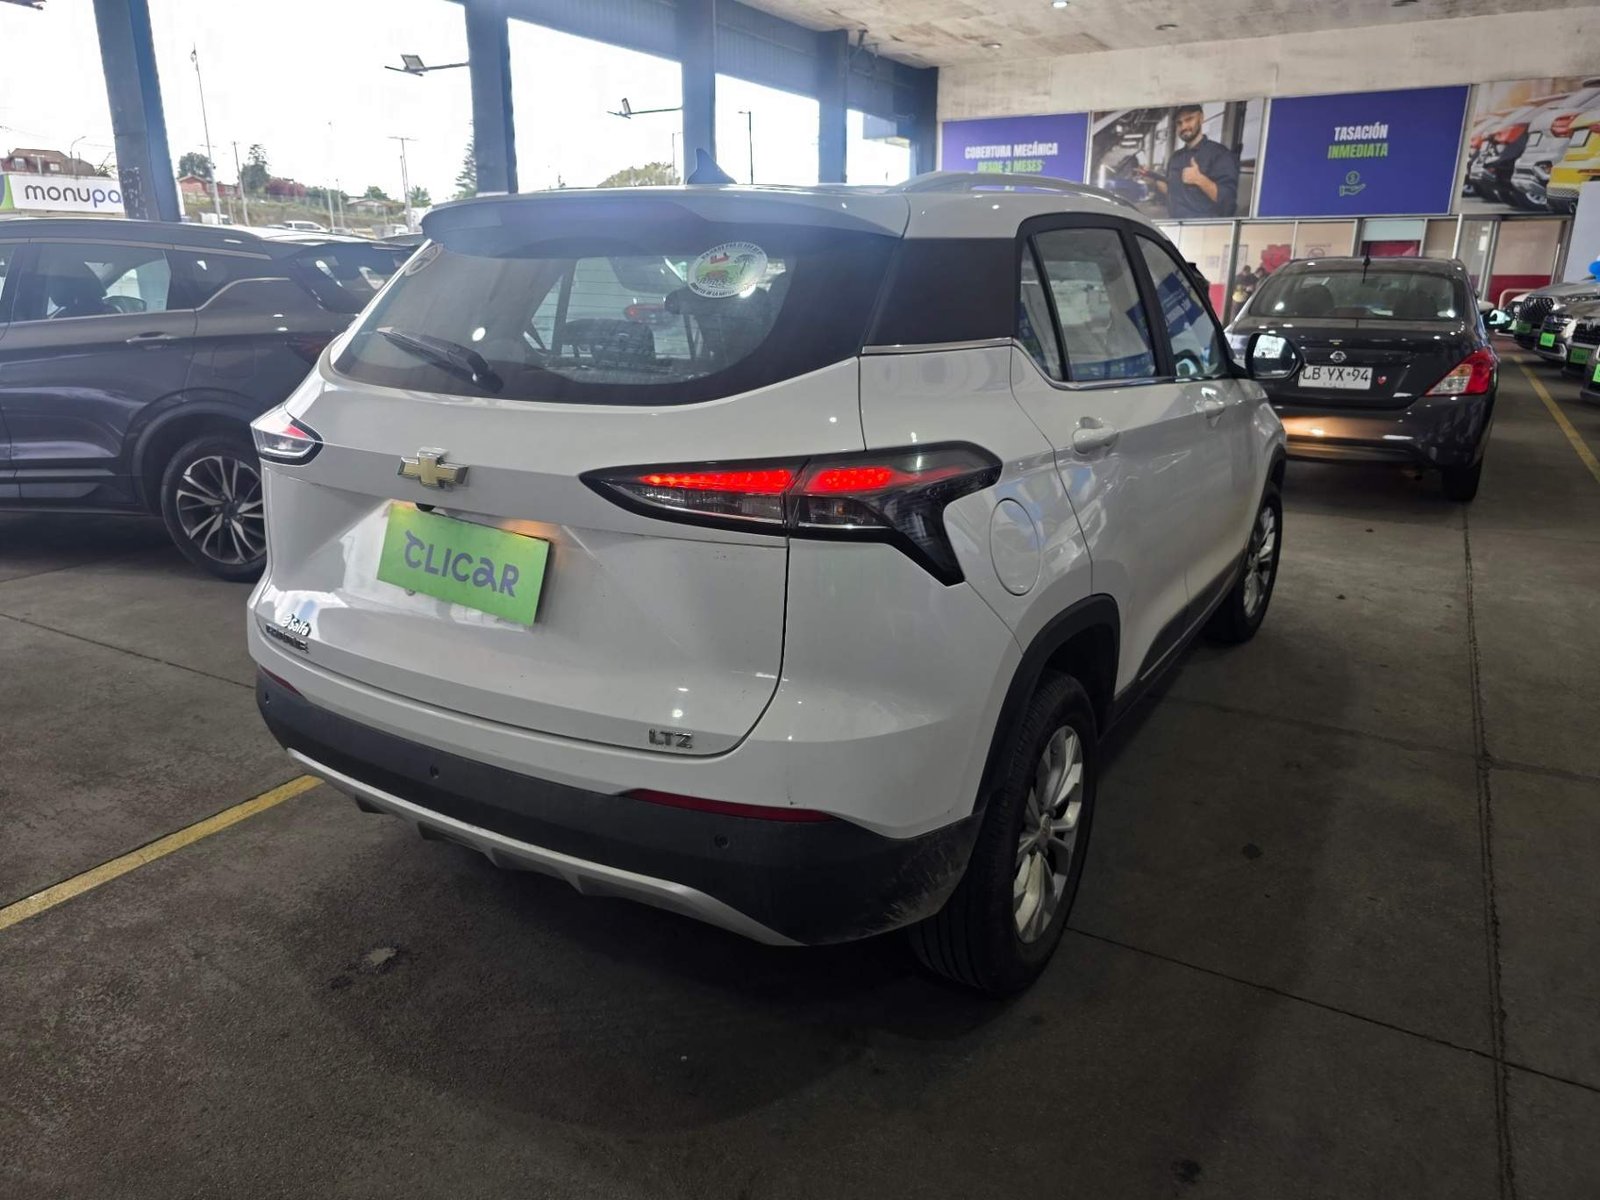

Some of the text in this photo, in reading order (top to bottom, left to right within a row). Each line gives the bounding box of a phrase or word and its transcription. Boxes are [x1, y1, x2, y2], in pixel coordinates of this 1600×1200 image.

[1334, 121, 1388, 141] TASACIÓN
[964, 140, 1058, 159] COBERTURA MECÁNICA
[1327, 142, 1388, 159] INMEDIATA
[287, 616, 310, 637] Salfa
[648, 728, 693, 749] LTZ
